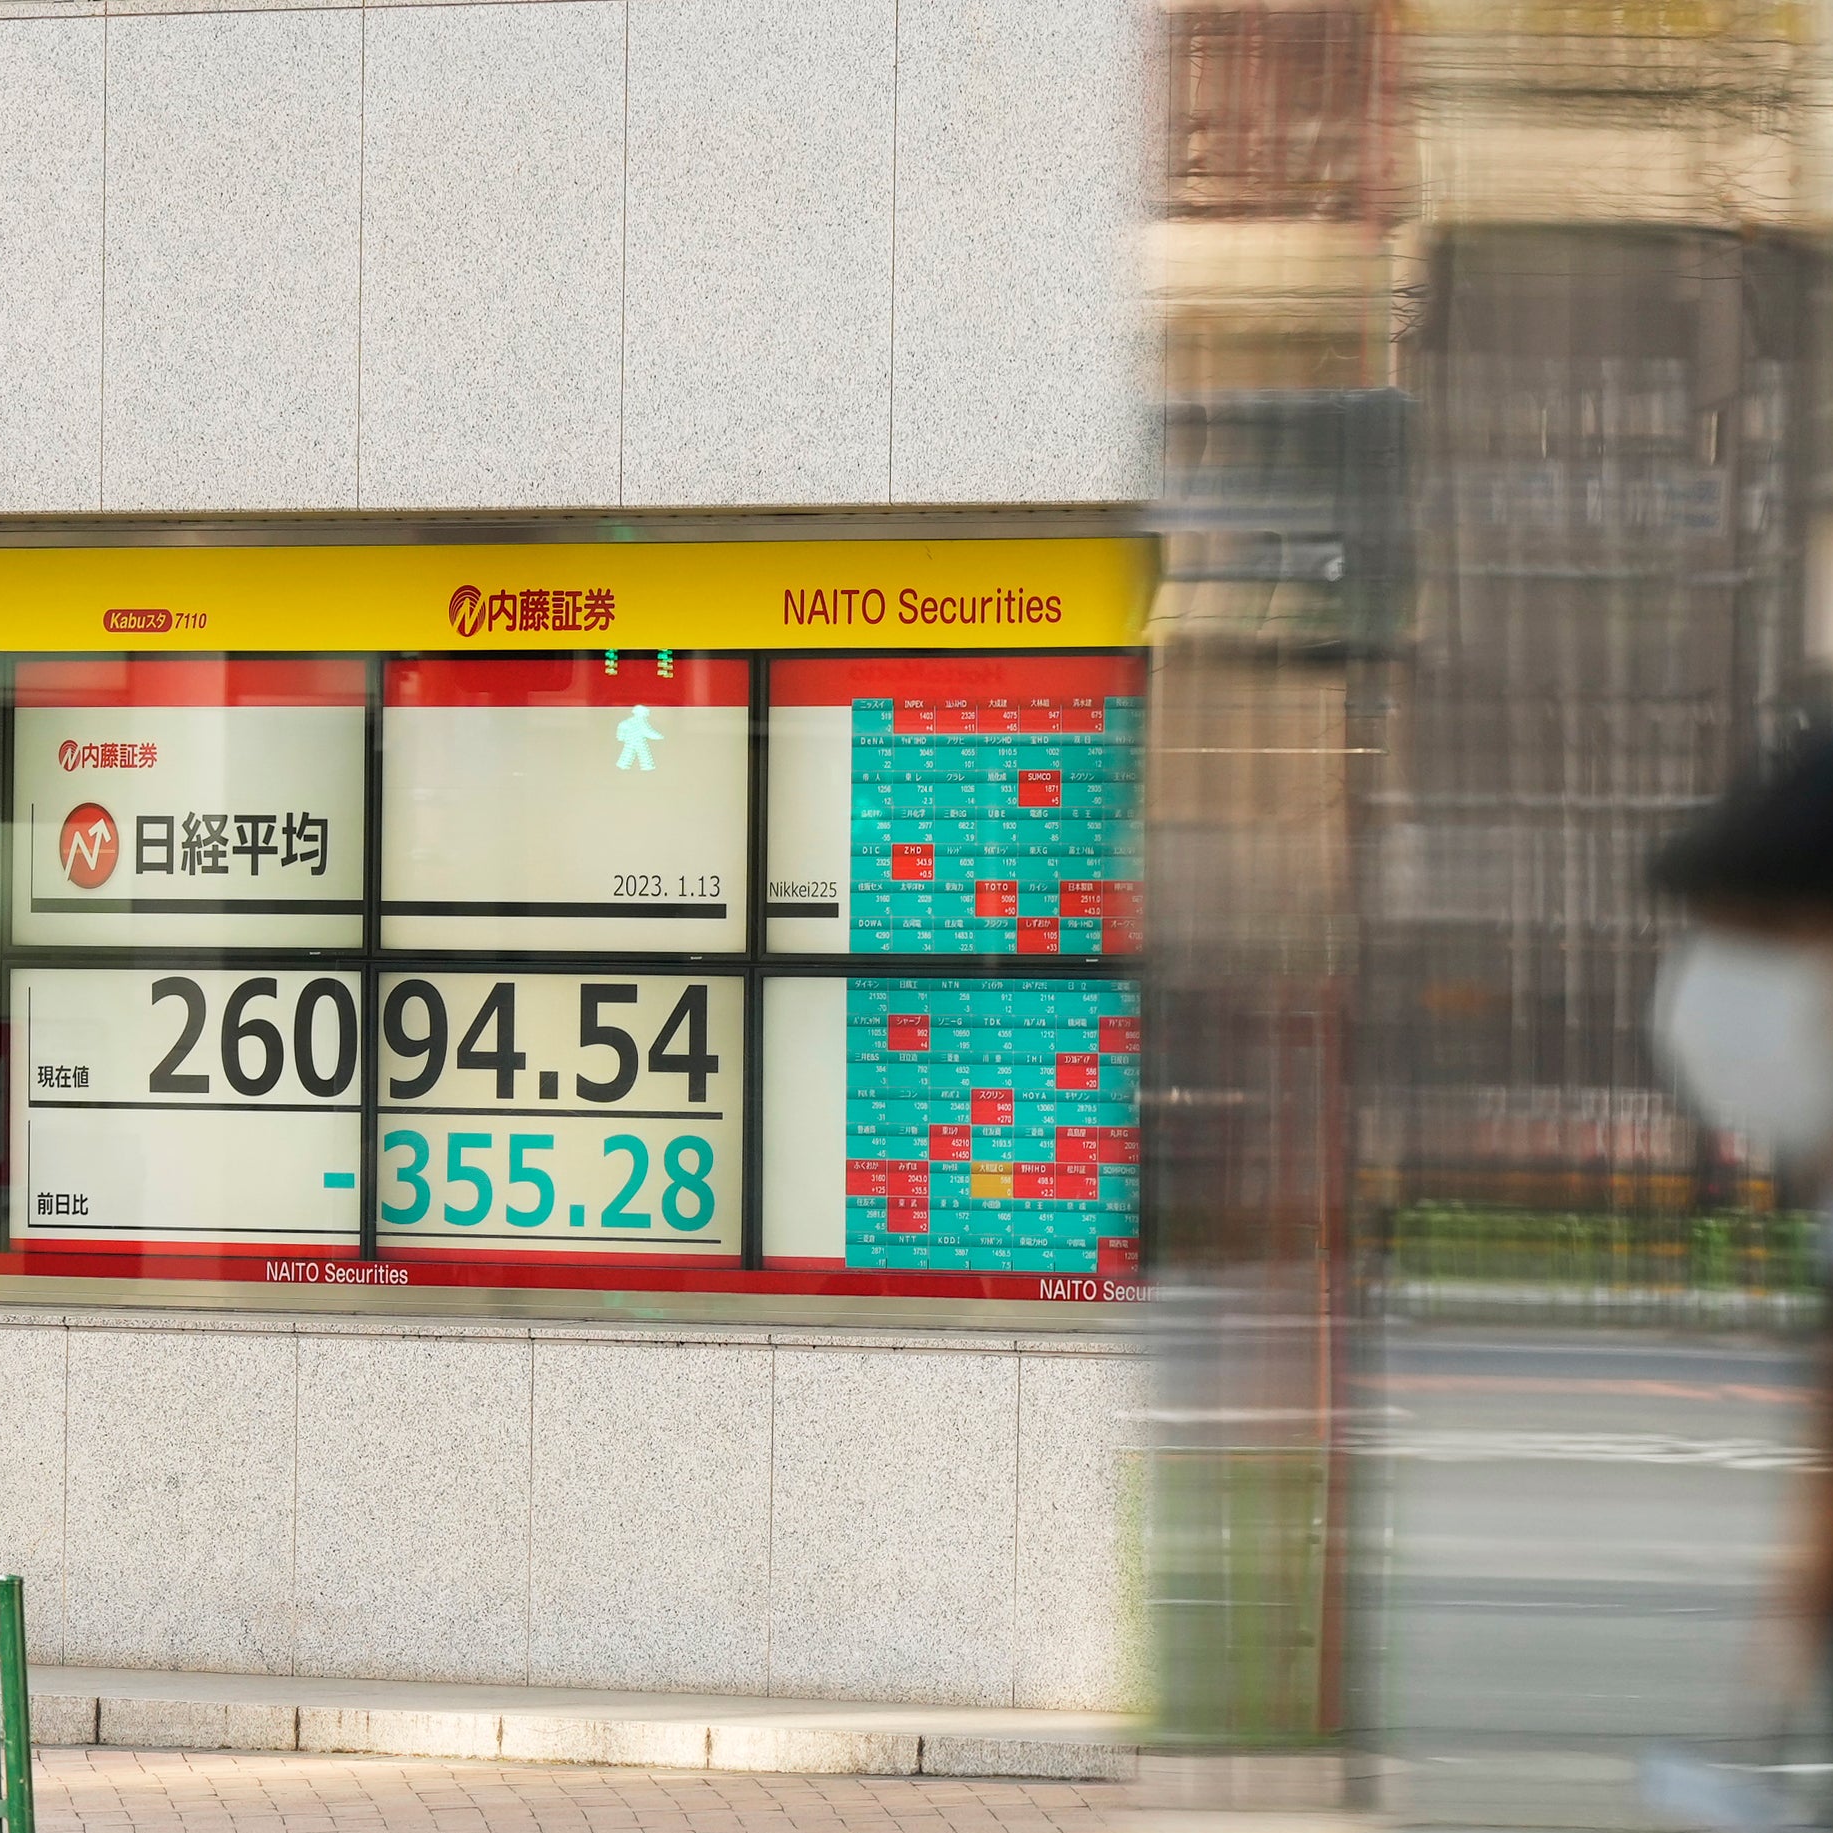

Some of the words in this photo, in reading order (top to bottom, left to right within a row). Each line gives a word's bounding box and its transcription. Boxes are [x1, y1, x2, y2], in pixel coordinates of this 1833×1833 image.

[488, 588, 616, 632] 内藤証券
[783, 587, 886, 625] NAITO
[898, 586, 1063, 625] Securities
[109, 612, 167, 630] Kabuスタ
[174, 612, 208, 630] 7110
[905, 700, 923, 708] INPEX
[861, 737, 883, 745] DeNA
[81, 742, 158, 769] 内藤証券
[135, 811, 329, 876] 日経平均
[863, 846, 879, 854] DIC
[613, 874, 668, 898] 2023.
[678, 875, 722, 898] 1.13
[769, 881, 838, 898] Nikkei225
[985, 881, 1008, 891] TOTO
[859, 919, 882, 927] DOWA
[898, 1016, 921, 1025] シャープ
[148, 976, 720, 1102] 26094.54
[37, 1065, 90, 1089] 現在値
[37, 1192, 90, 1217] 前日比
[266, 1261, 319, 1282] NAITO
[324, 1263, 409, 1285] Securities
[1039, 1279, 1098, 1301] NAITO
